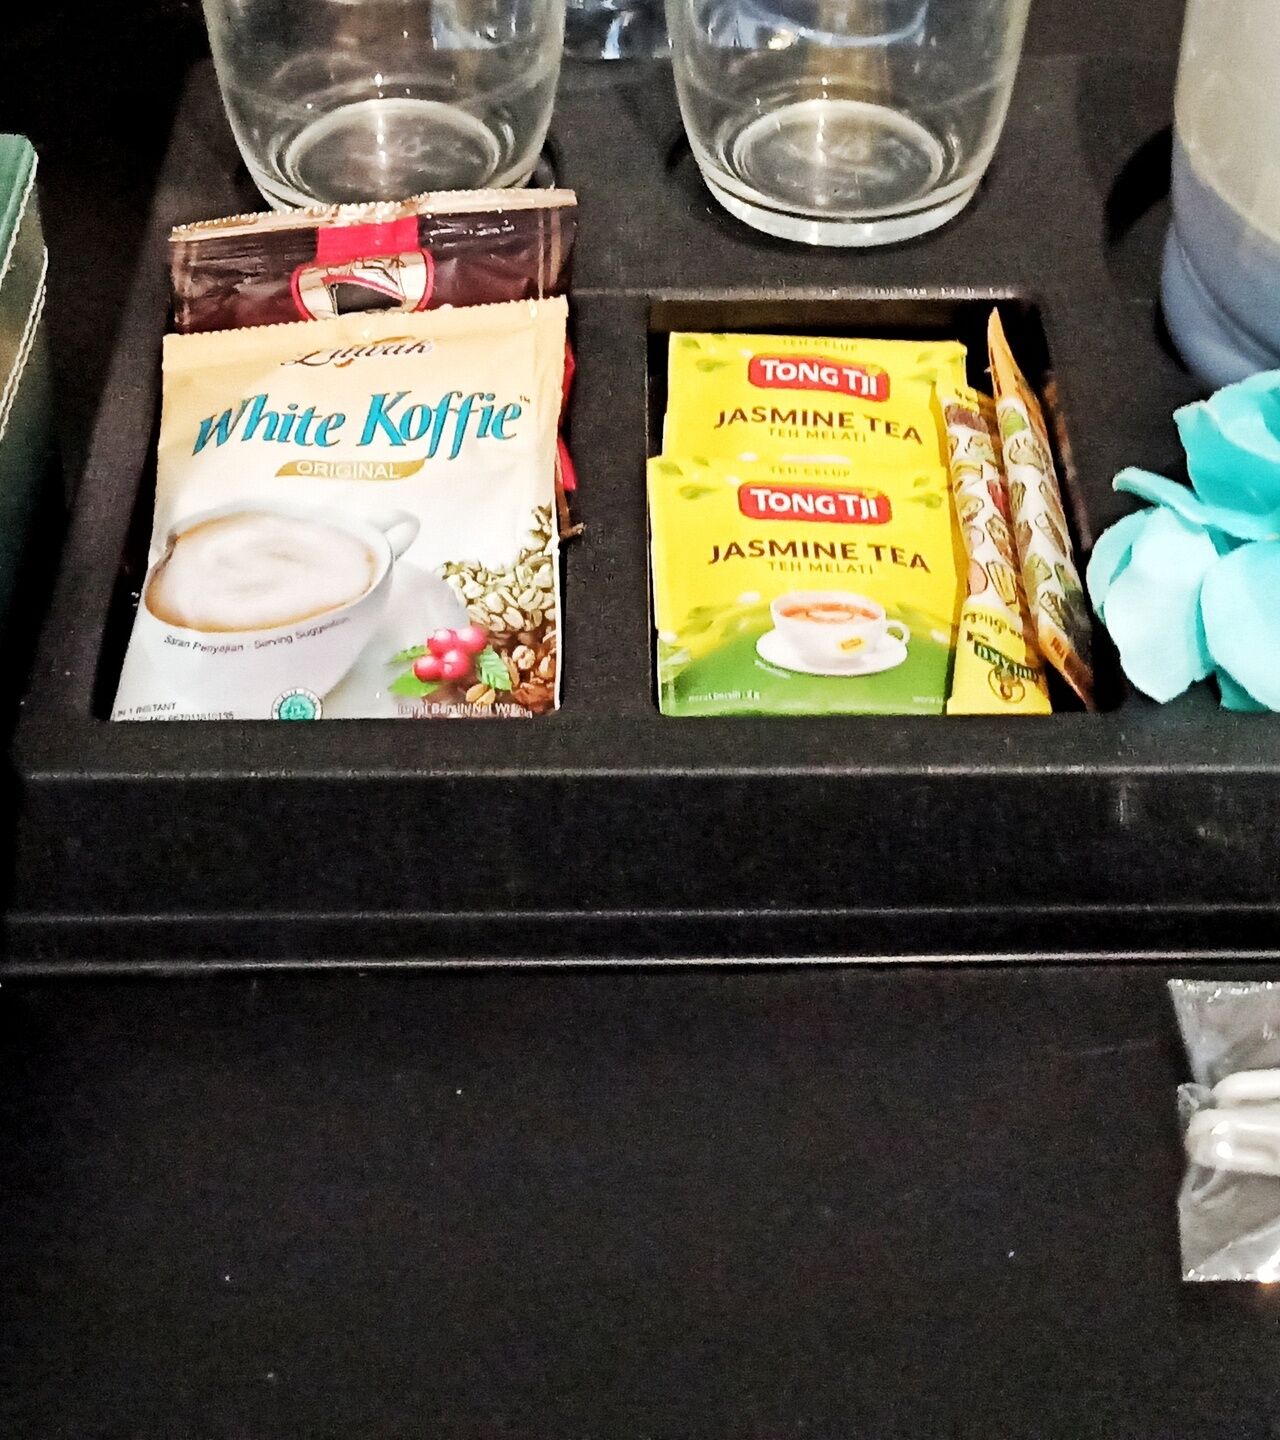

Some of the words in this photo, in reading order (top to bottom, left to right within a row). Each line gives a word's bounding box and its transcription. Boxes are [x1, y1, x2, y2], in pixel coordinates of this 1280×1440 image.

[760, 359, 839, 386] TONG
[842, 368, 878, 396] TJI
[192, 392, 346, 456] White
[356, 390, 523, 460] Koffie
[713, 406, 855, 431] JASMINE
[863, 414, 923, 446] TEA
[769, 427, 800, 439] TEH
[805, 429, 867, 443] MELATI
[295, 459, 402, 480] ORIGINAL
[750, 488, 836, 516] TONG
[838, 493, 879, 519] TJI
[708, 539, 857, 565] JASMINE
[867, 543, 932, 574] TEA
[768, 560, 802, 572] TEH
[809, 561, 874, 575] MELATI
